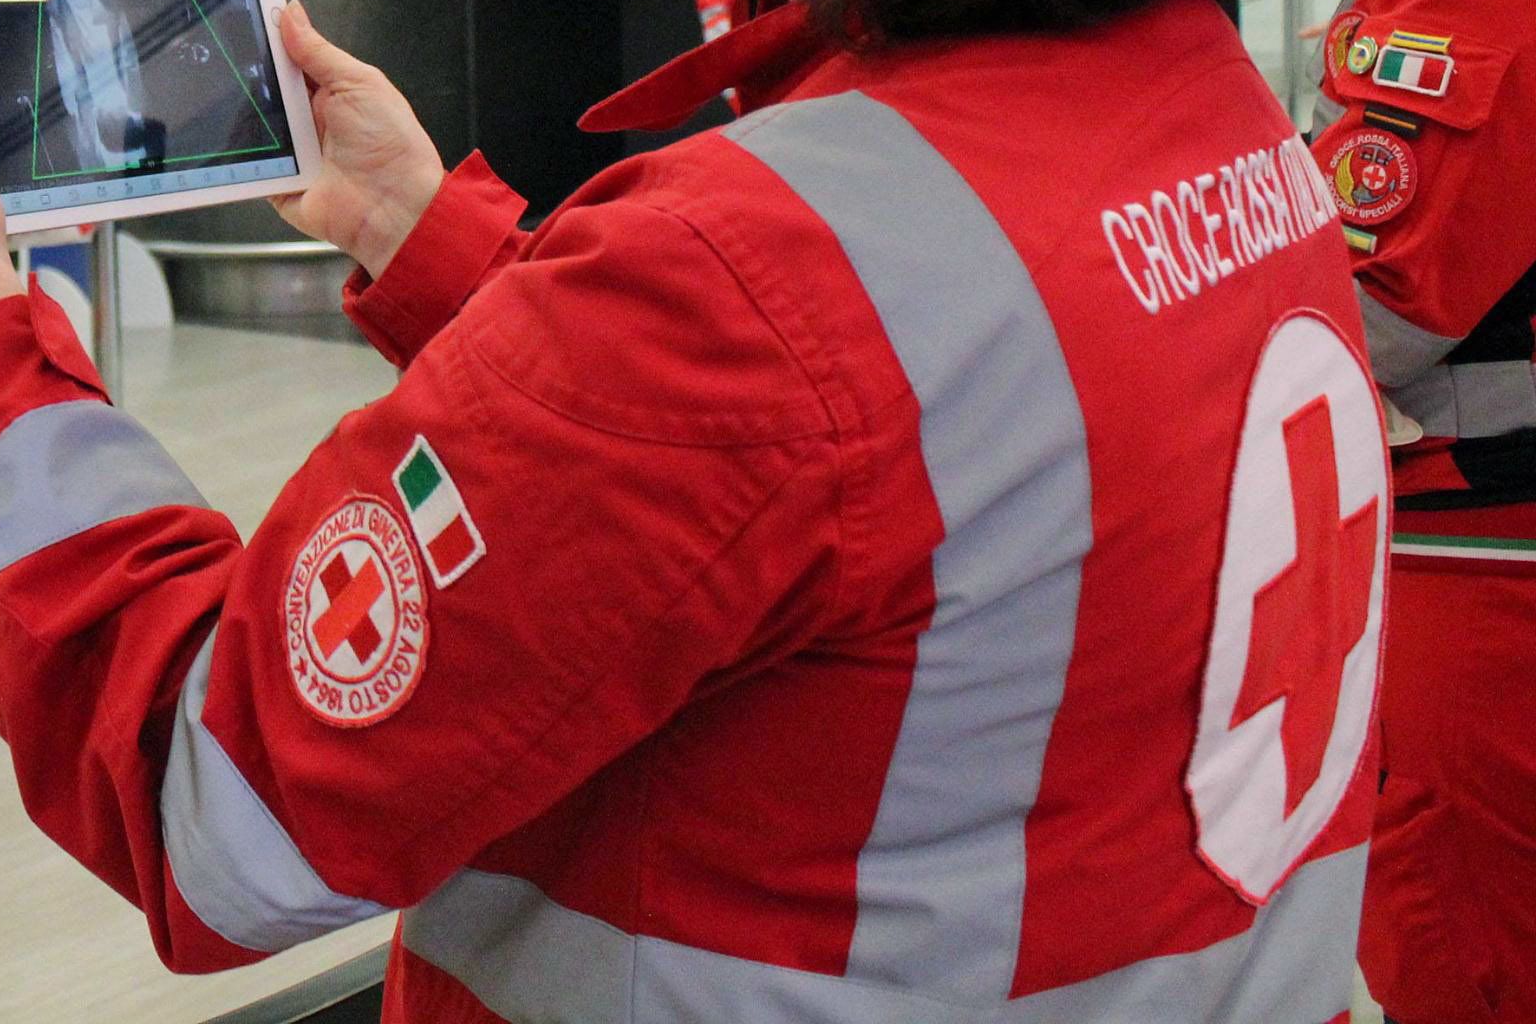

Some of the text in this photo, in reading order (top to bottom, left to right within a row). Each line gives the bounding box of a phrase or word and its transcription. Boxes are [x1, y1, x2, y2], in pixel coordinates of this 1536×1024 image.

[1101, 173, 1235, 315] CROCE
[288, 505, 421, 715] CONVENZIONE DI GINEVRA 22 AGOSTO 1864
